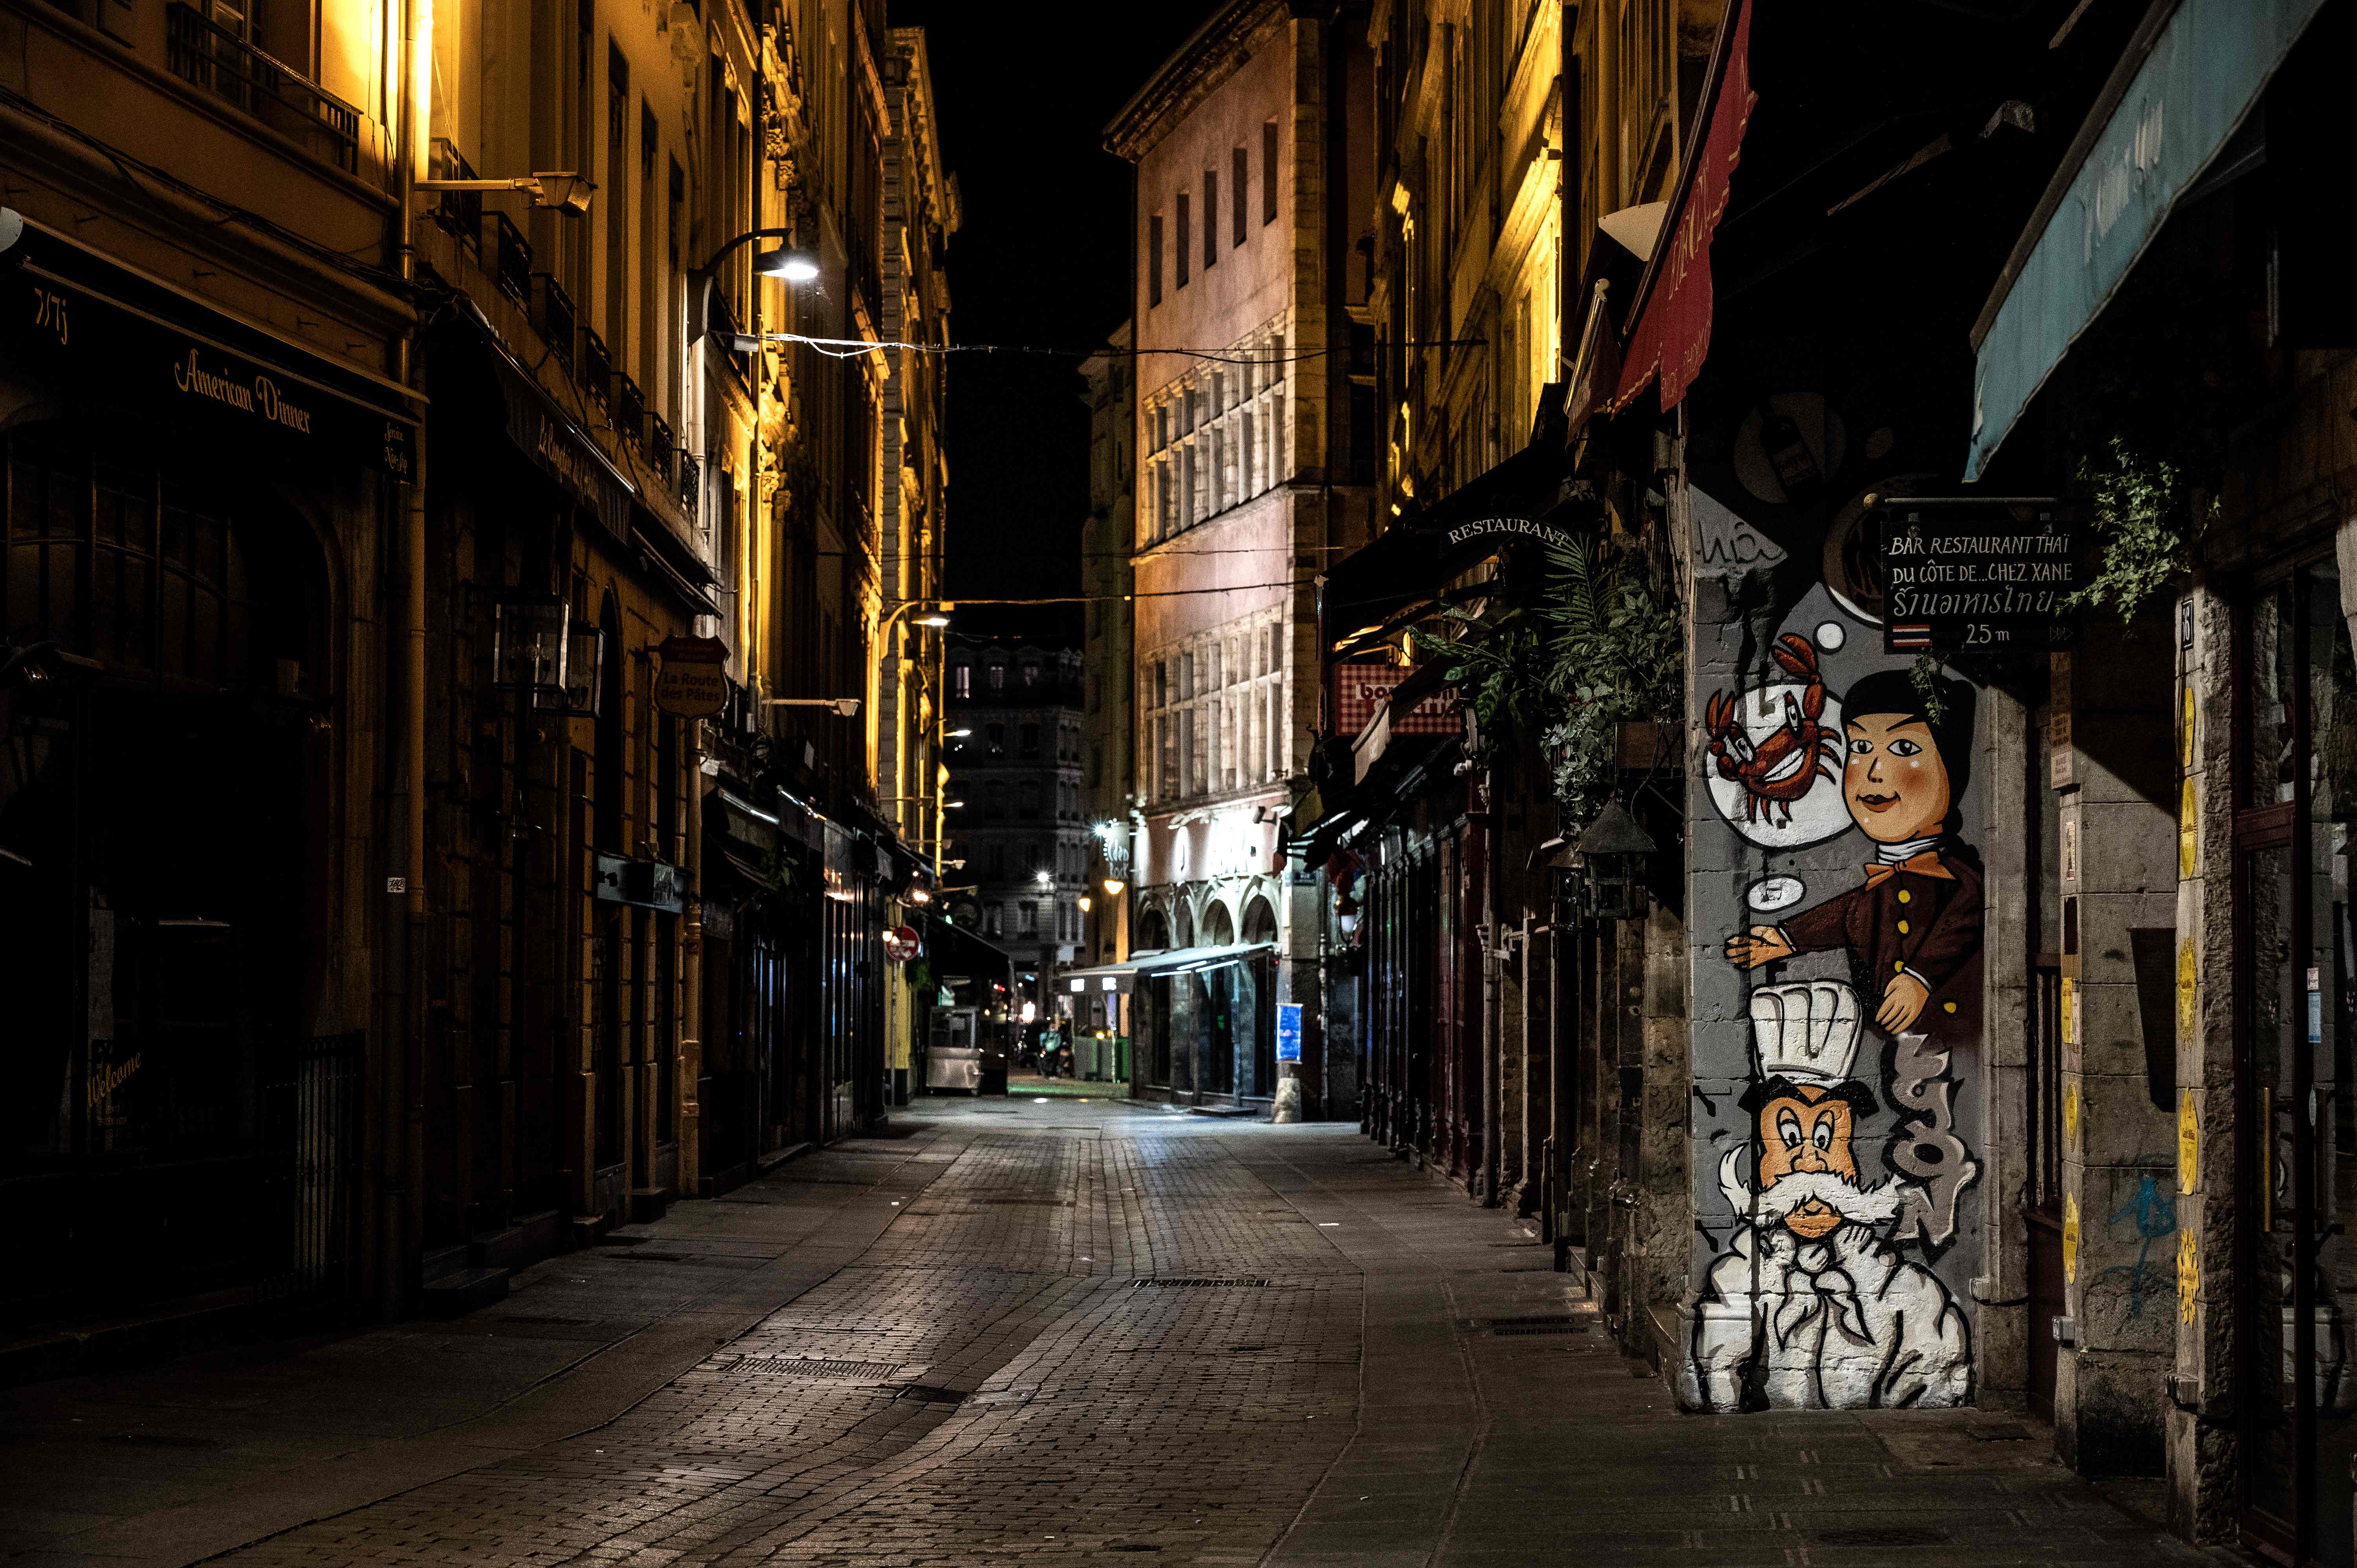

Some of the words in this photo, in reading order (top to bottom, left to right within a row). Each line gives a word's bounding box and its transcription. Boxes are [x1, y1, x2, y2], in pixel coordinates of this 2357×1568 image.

[174, 348, 254, 412] American
[255, 375, 310, 434] Dinner
[1448, 518, 1568, 548] RESTAURANT
[1888, 537, 1926, 555] BAR
[1930, 536, 2033, 554] RESTAURANT
[2036, 533, 2070, 553] THAÏ
[1893, 568, 1915, 584] DU
[1920, 558, 1956, 583] CÔTE
[2031, 562, 2073, 581] XANE
[1965, 623, 1992, 644] 25
[1995, 630, 2010, 641] m
[665, 672, 678, 684] La
[682, 672, 718, 687] Route
[660, 687, 682, 698] des
[687, 687, 720, 702] Pâtes
[87, 1052, 142, 1107] Welcome
